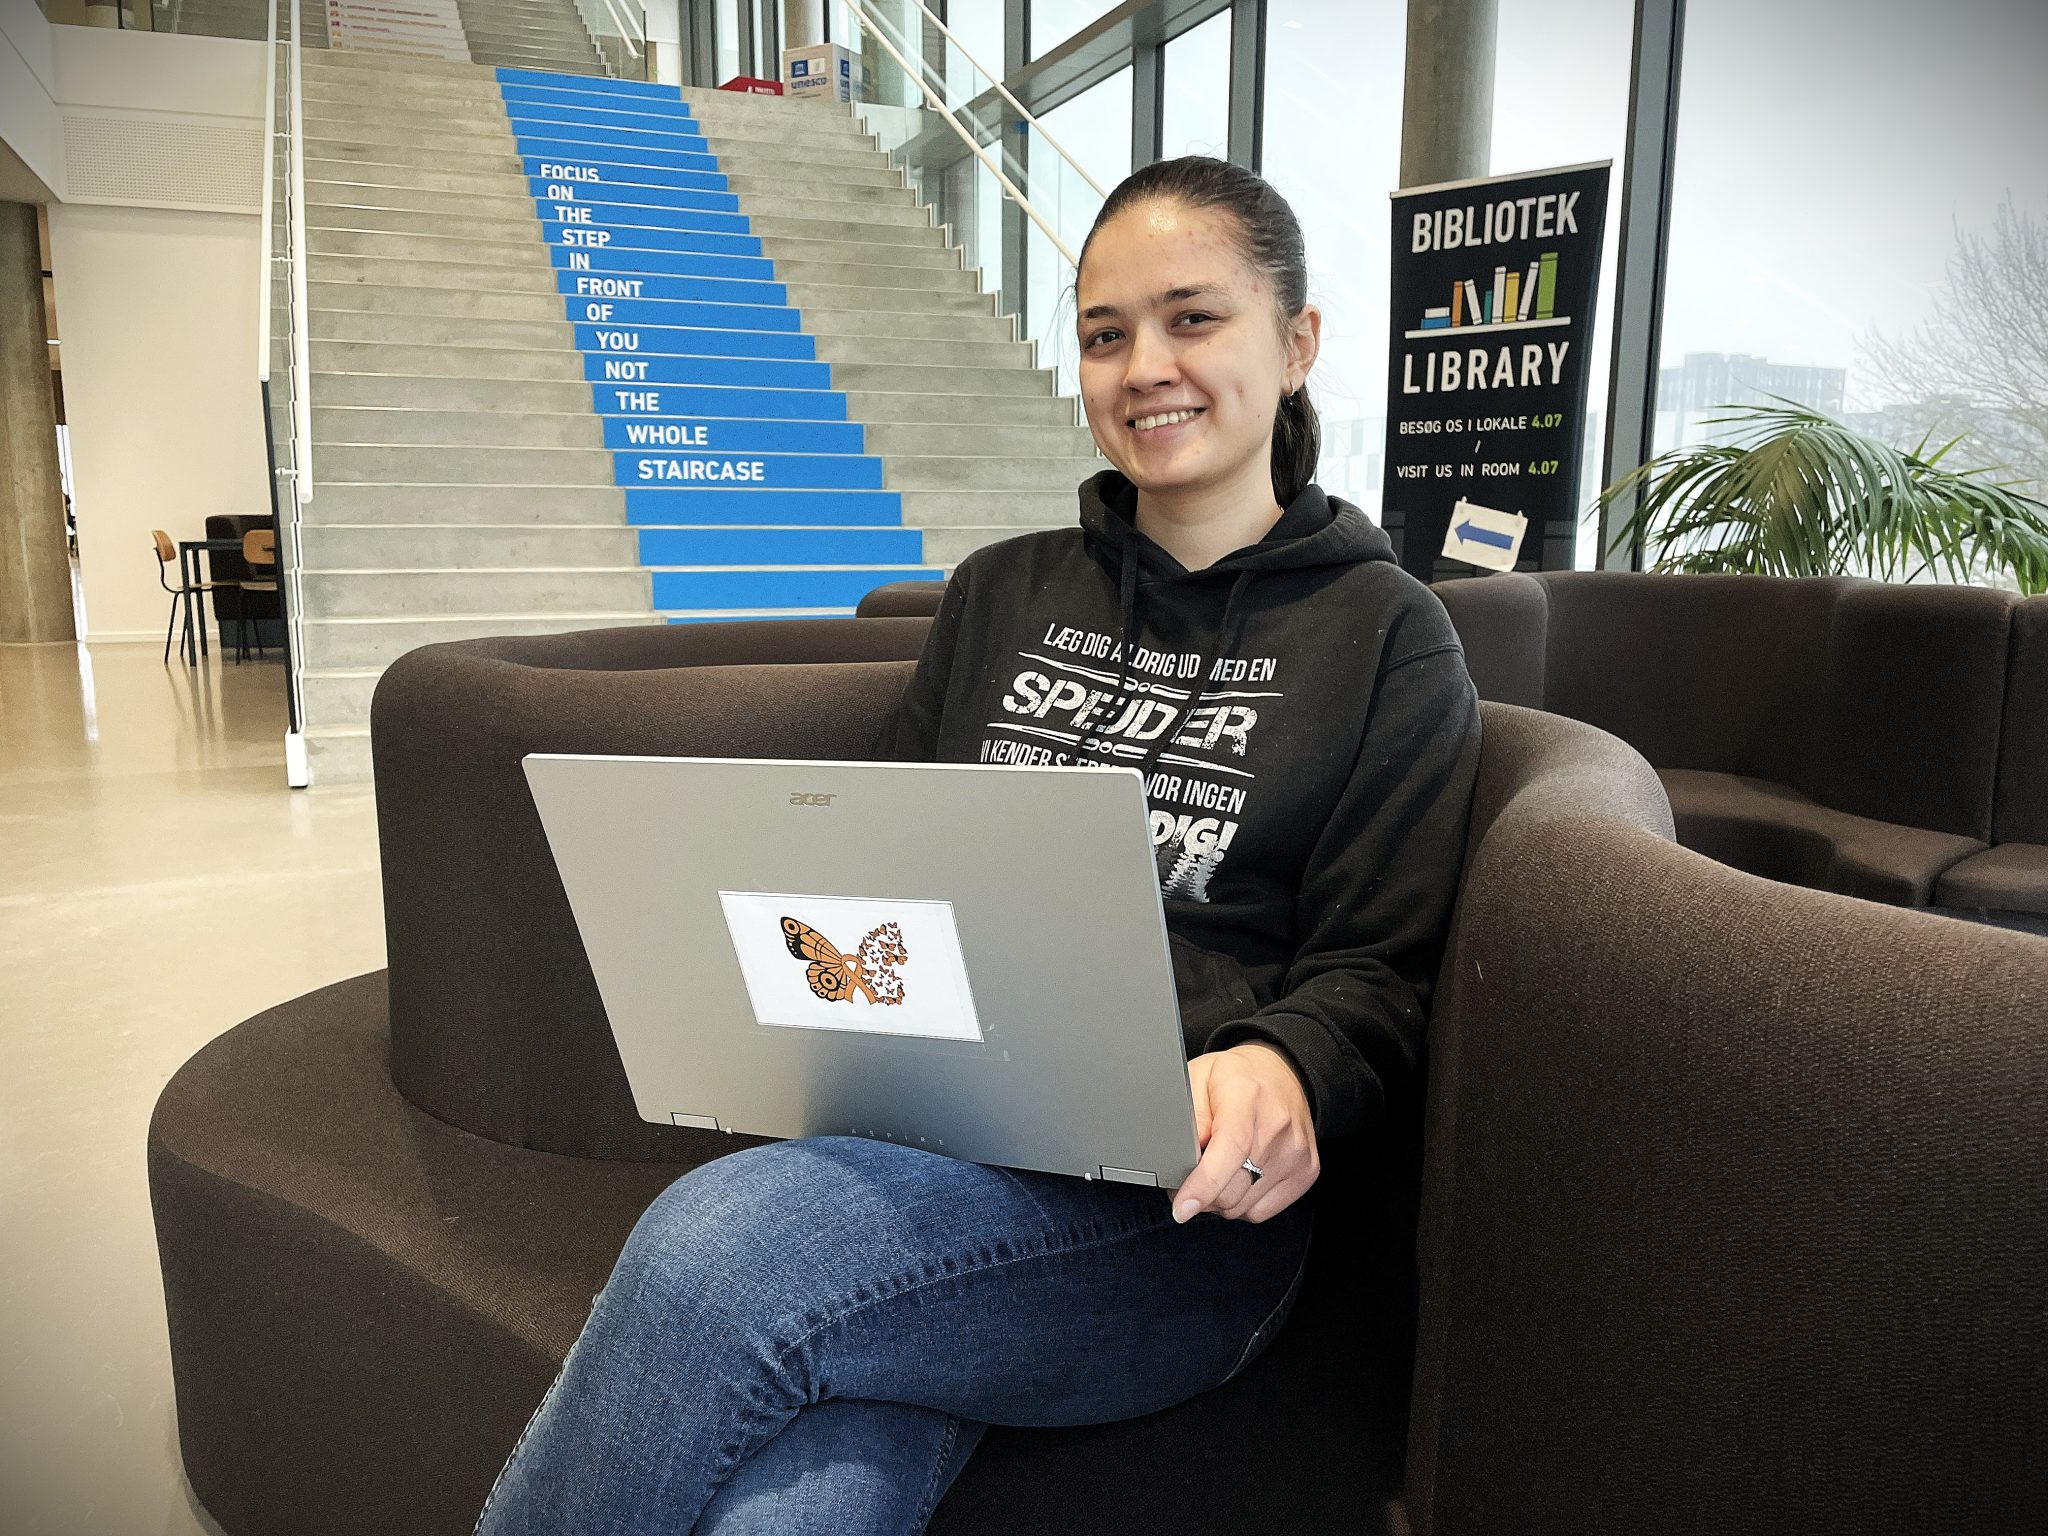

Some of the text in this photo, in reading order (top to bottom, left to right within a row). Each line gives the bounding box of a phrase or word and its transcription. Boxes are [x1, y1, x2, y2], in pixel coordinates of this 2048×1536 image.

[540, 164, 600, 182] FOCUS
[547, 184, 574, 200] ON
[554, 205, 592, 223] THE
[1411, 190, 1581, 253] BIBLIOTEK
[562, 229, 610, 247] STEP
[569, 252, 590, 270] IN
[576, 277, 643, 297] FRONT
[586, 304, 614, 321] OF
[596, 331, 639, 350] YOU
[604, 361, 649, 380] NOT
[1402, 341, 1570, 394] LIBRARY
[615, 391, 660, 411] THE
[1399, 413, 1563, 435] BESØG OS I LOKALE 4.07
[626, 425, 708, 445] WHOLE
[637, 460, 765, 481] STAIRCASE
[1396, 460, 1559, 478] VISIT US IN ROOM 4.07
[1043, 623, 1084, 653] LÆG
[1081, 632, 1113, 659] DIG
[1177, 653, 1201, 679] UD
[1248, 658, 1277, 682] EN
[1002, 670, 1258, 757] SPEJDER
[990, 740, 1053, 767] KENDER
[790, 792, 837, 806] acer
[1145, 772, 1247, 815] VOR INGEN
